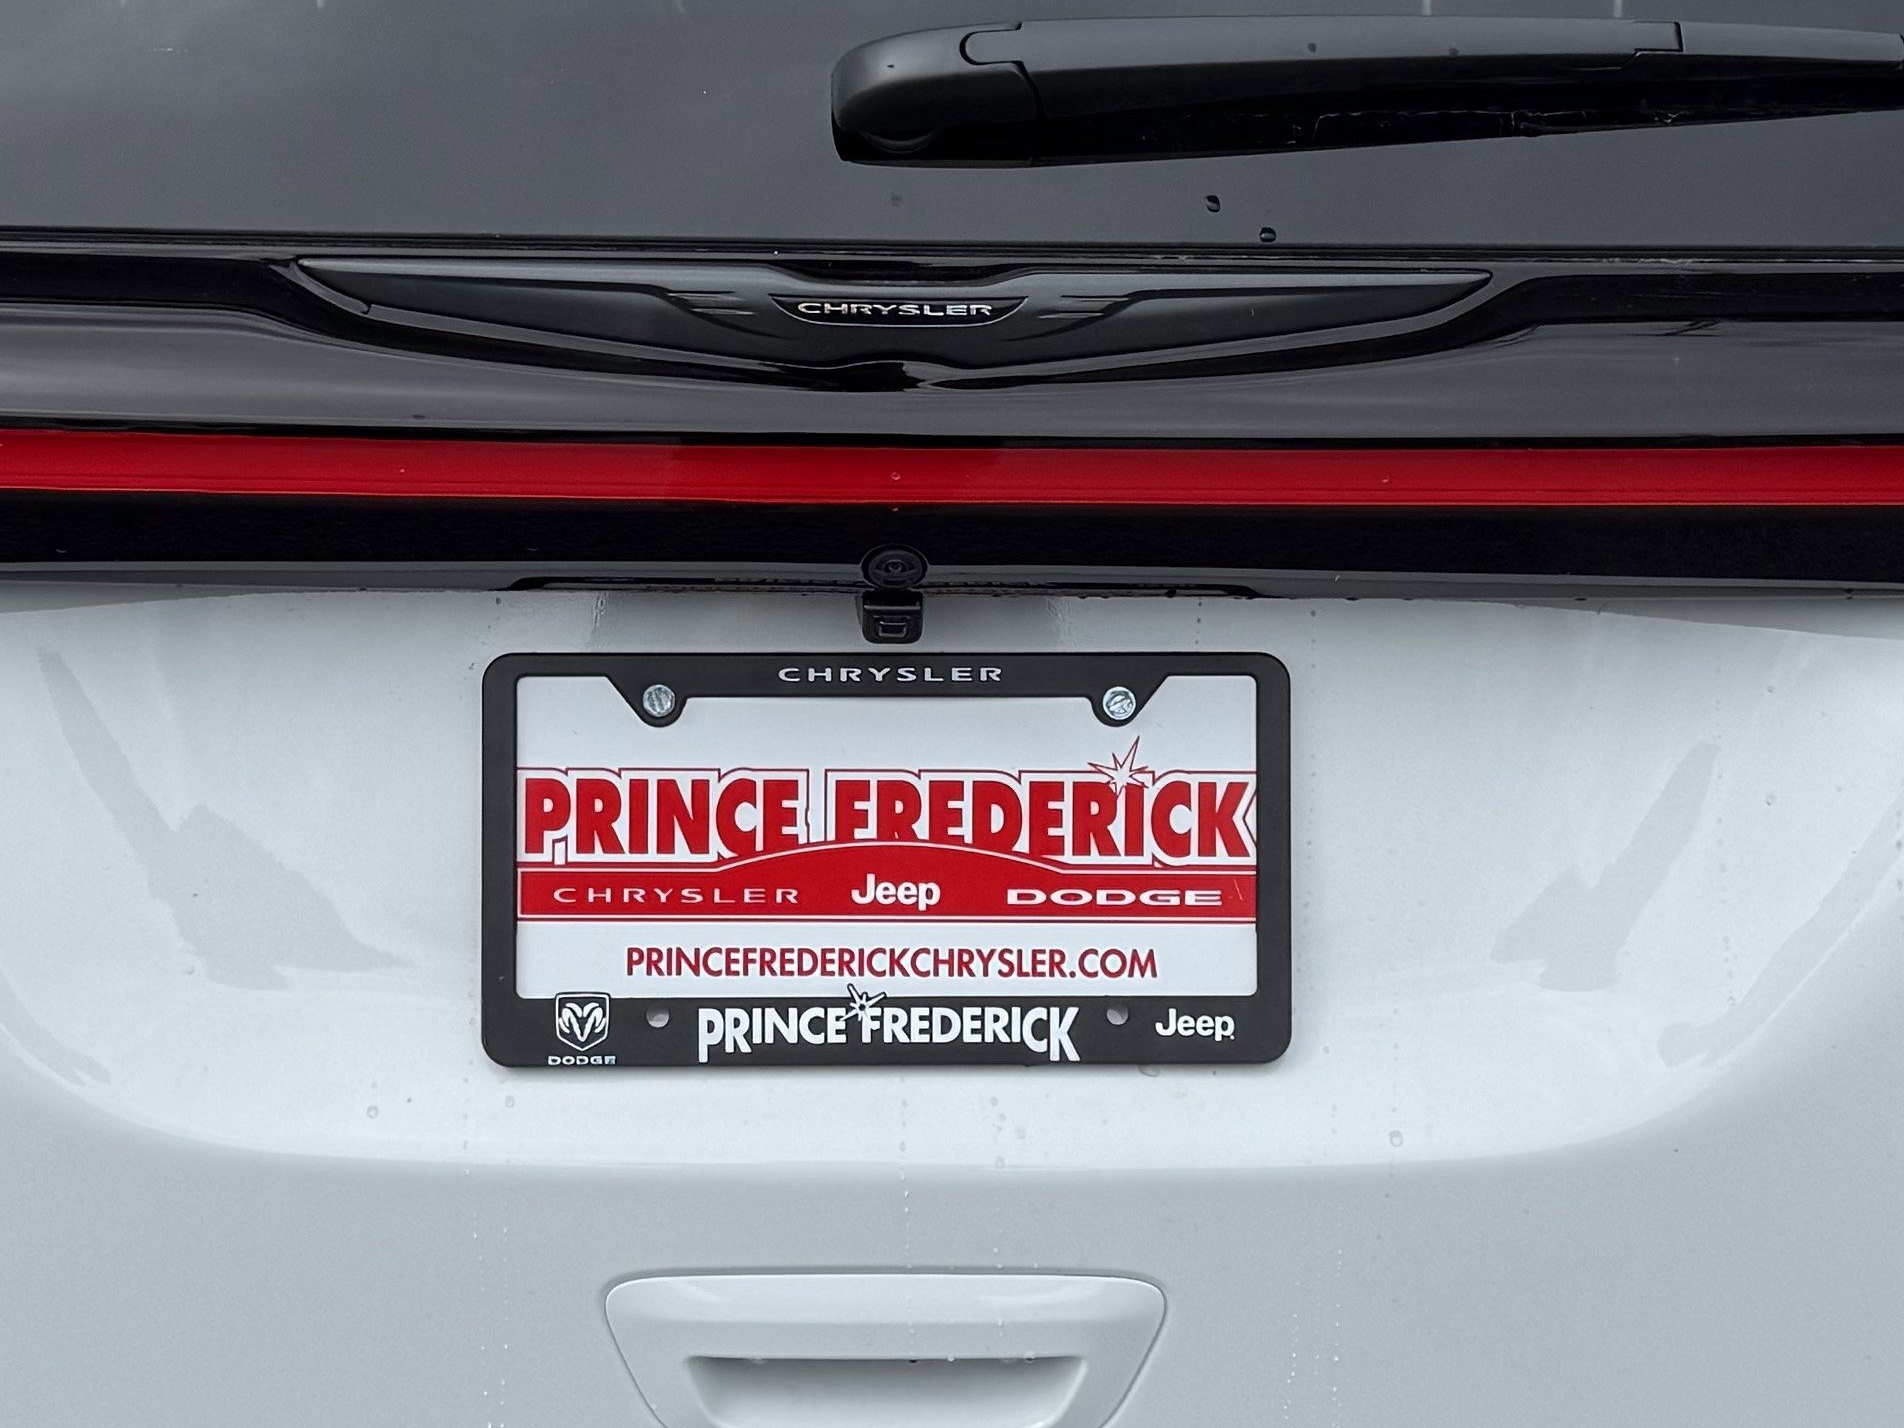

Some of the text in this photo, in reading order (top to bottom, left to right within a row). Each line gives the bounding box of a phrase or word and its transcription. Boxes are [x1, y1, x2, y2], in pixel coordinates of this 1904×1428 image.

[797, 301, 993, 317] CHRYSLER
[777, 667, 1002, 682] CHRYSLER
[524, 778, 1251, 857] PRINCE FREDERICK
[553, 873, 1223, 911] CHRYSLER Jeep DODGE
[626, 946, 1158, 979] PRINCEFREDERICKCHRYSLER.COM
[698, 1006, 1080, 1063] PRINCE FREDERICK
[1155, 1008, 1234, 1042] Jeep
[547, 1055, 616, 1066] DODGE
